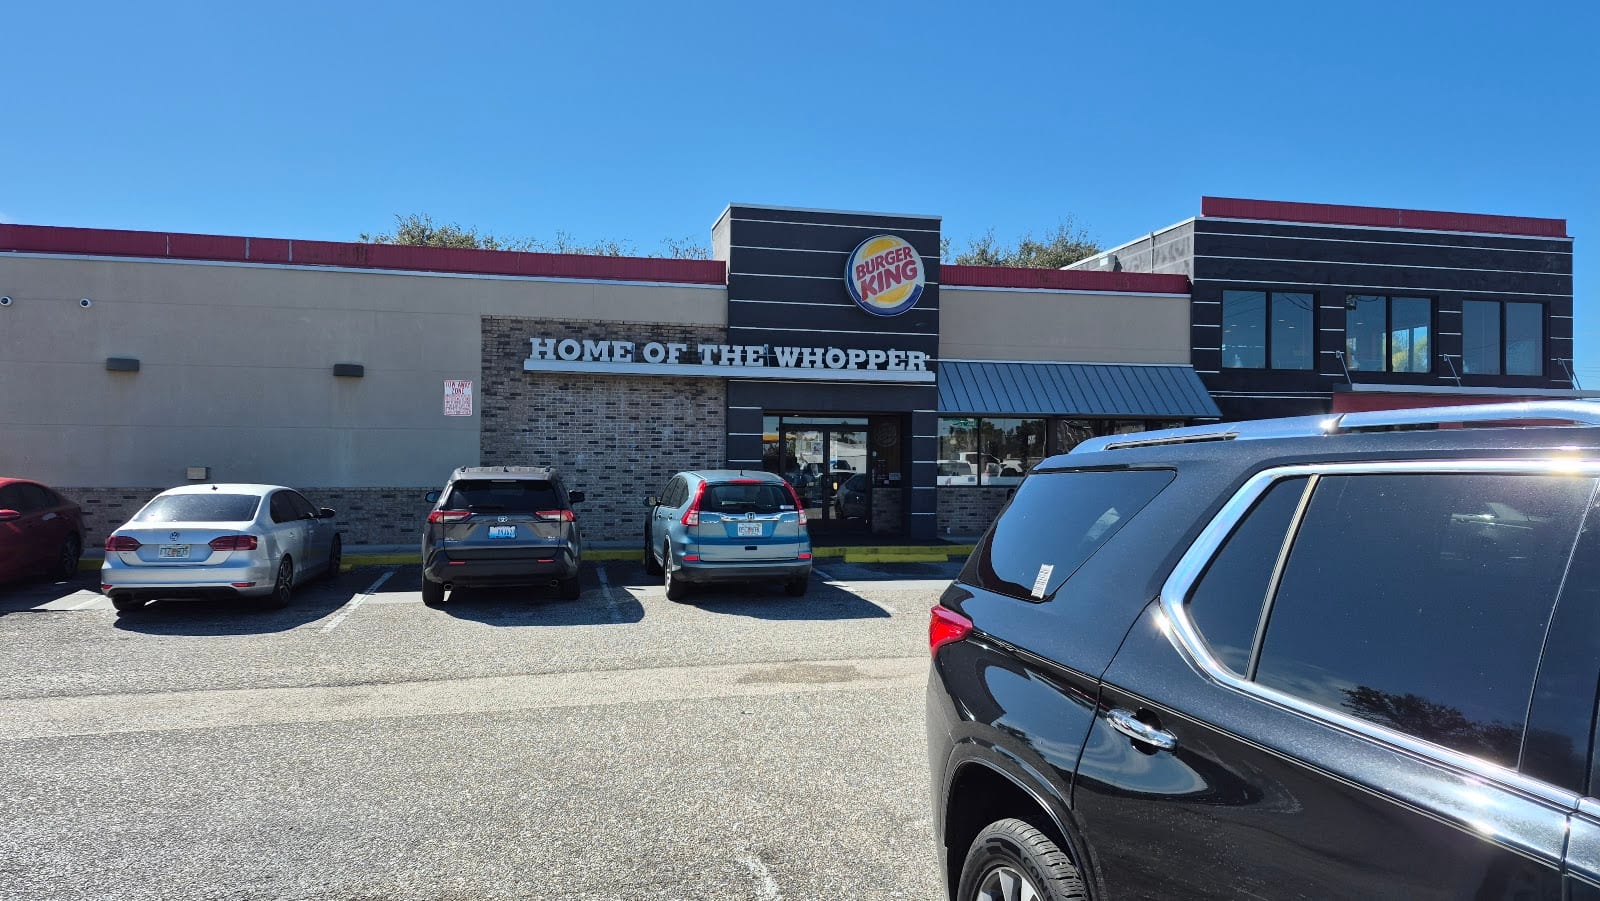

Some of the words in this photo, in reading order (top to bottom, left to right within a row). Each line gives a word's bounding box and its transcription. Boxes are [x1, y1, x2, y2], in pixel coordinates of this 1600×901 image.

[855, 246, 914, 281] BURGER
[860, 259, 918, 303] KING
[529, 337, 635, 363] HOME
[642, 341, 688, 364] OF
[697, 343, 766, 367] THE
[773, 346, 927, 371] WHOPPER
